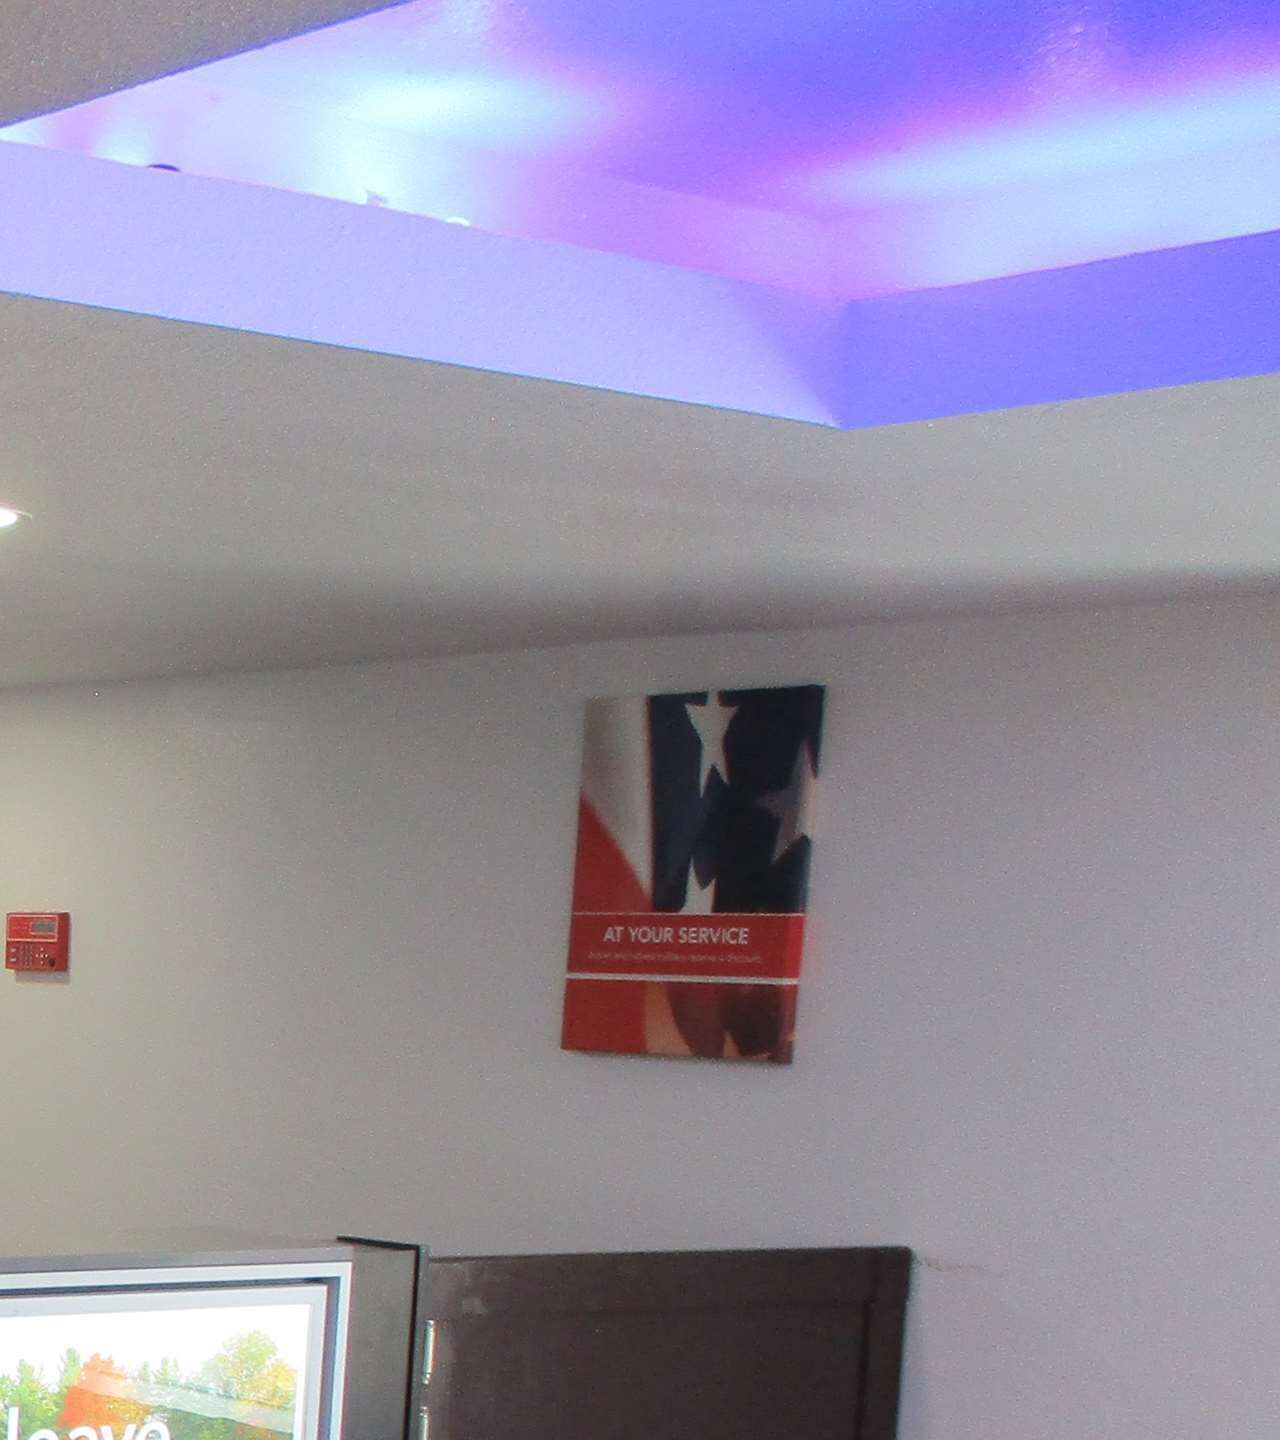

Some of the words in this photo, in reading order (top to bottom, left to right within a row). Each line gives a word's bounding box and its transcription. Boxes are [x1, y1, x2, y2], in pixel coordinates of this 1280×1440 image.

[603, 927, 624, 942] AT
[628, 927, 674, 944] YOUR
[678, 927, 750, 945] SERVICE
